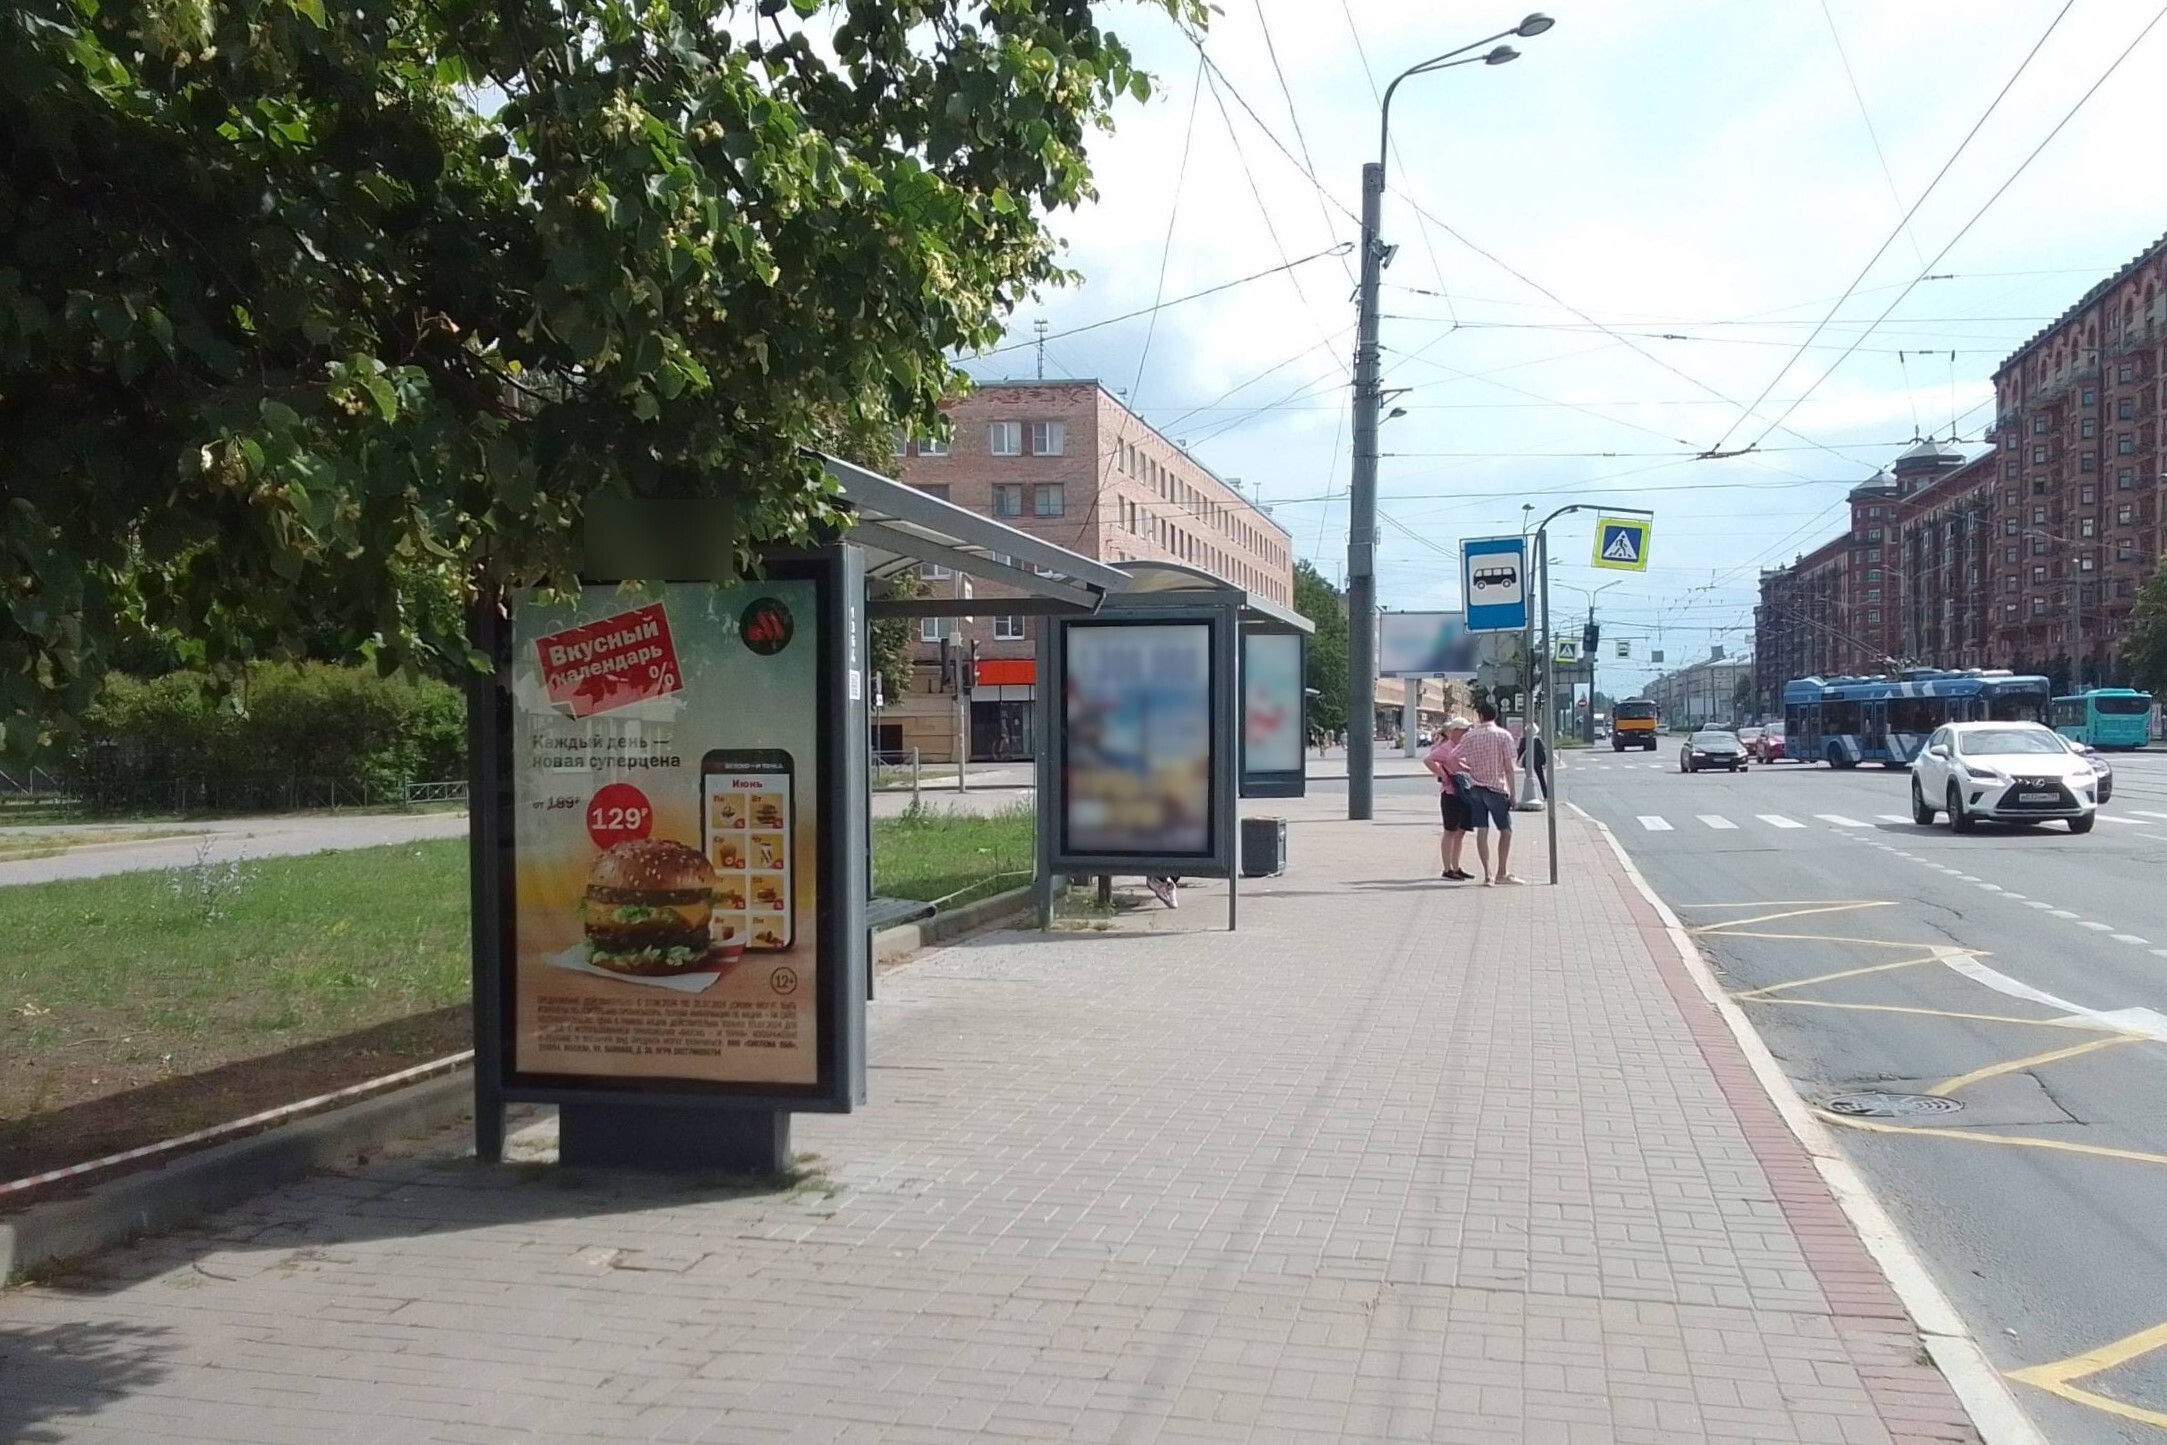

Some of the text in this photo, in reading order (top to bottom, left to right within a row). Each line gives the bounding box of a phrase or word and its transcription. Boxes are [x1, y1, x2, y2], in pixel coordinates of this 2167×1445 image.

[549, 615, 660, 667] Вкусный
[554, 645, 664, 687] календарь
[532, 734, 604, 751] Каждый
[607, 737, 648, 750] день
[532, 755, 681, 771] новая суперцена
[732, 779, 763, 789] Июнь
[775, 974, 794, 988] 12+
